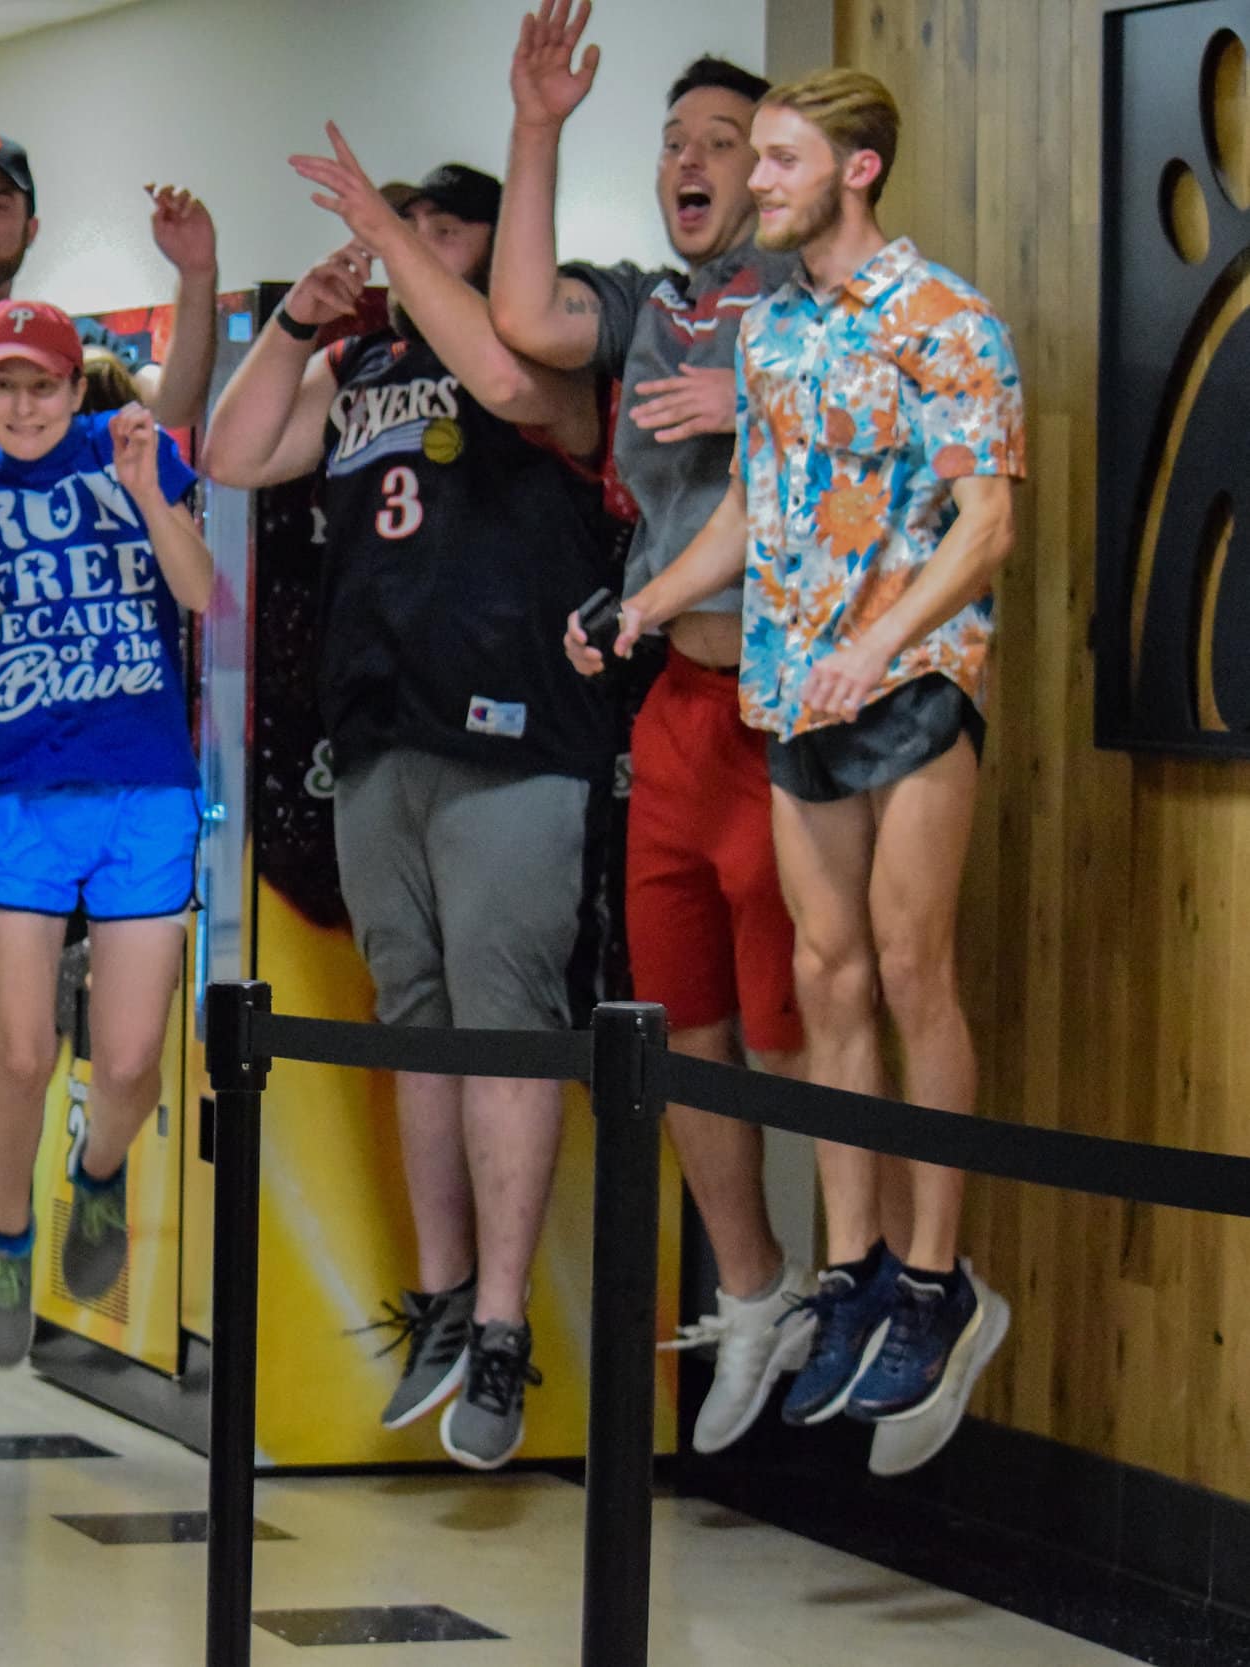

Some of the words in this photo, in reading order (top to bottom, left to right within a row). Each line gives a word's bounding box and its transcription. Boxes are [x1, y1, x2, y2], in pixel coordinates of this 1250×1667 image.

[374, 465, 424, 540] 3
[59, 636, 99, 662] of
[113, 634, 162, 662] the
